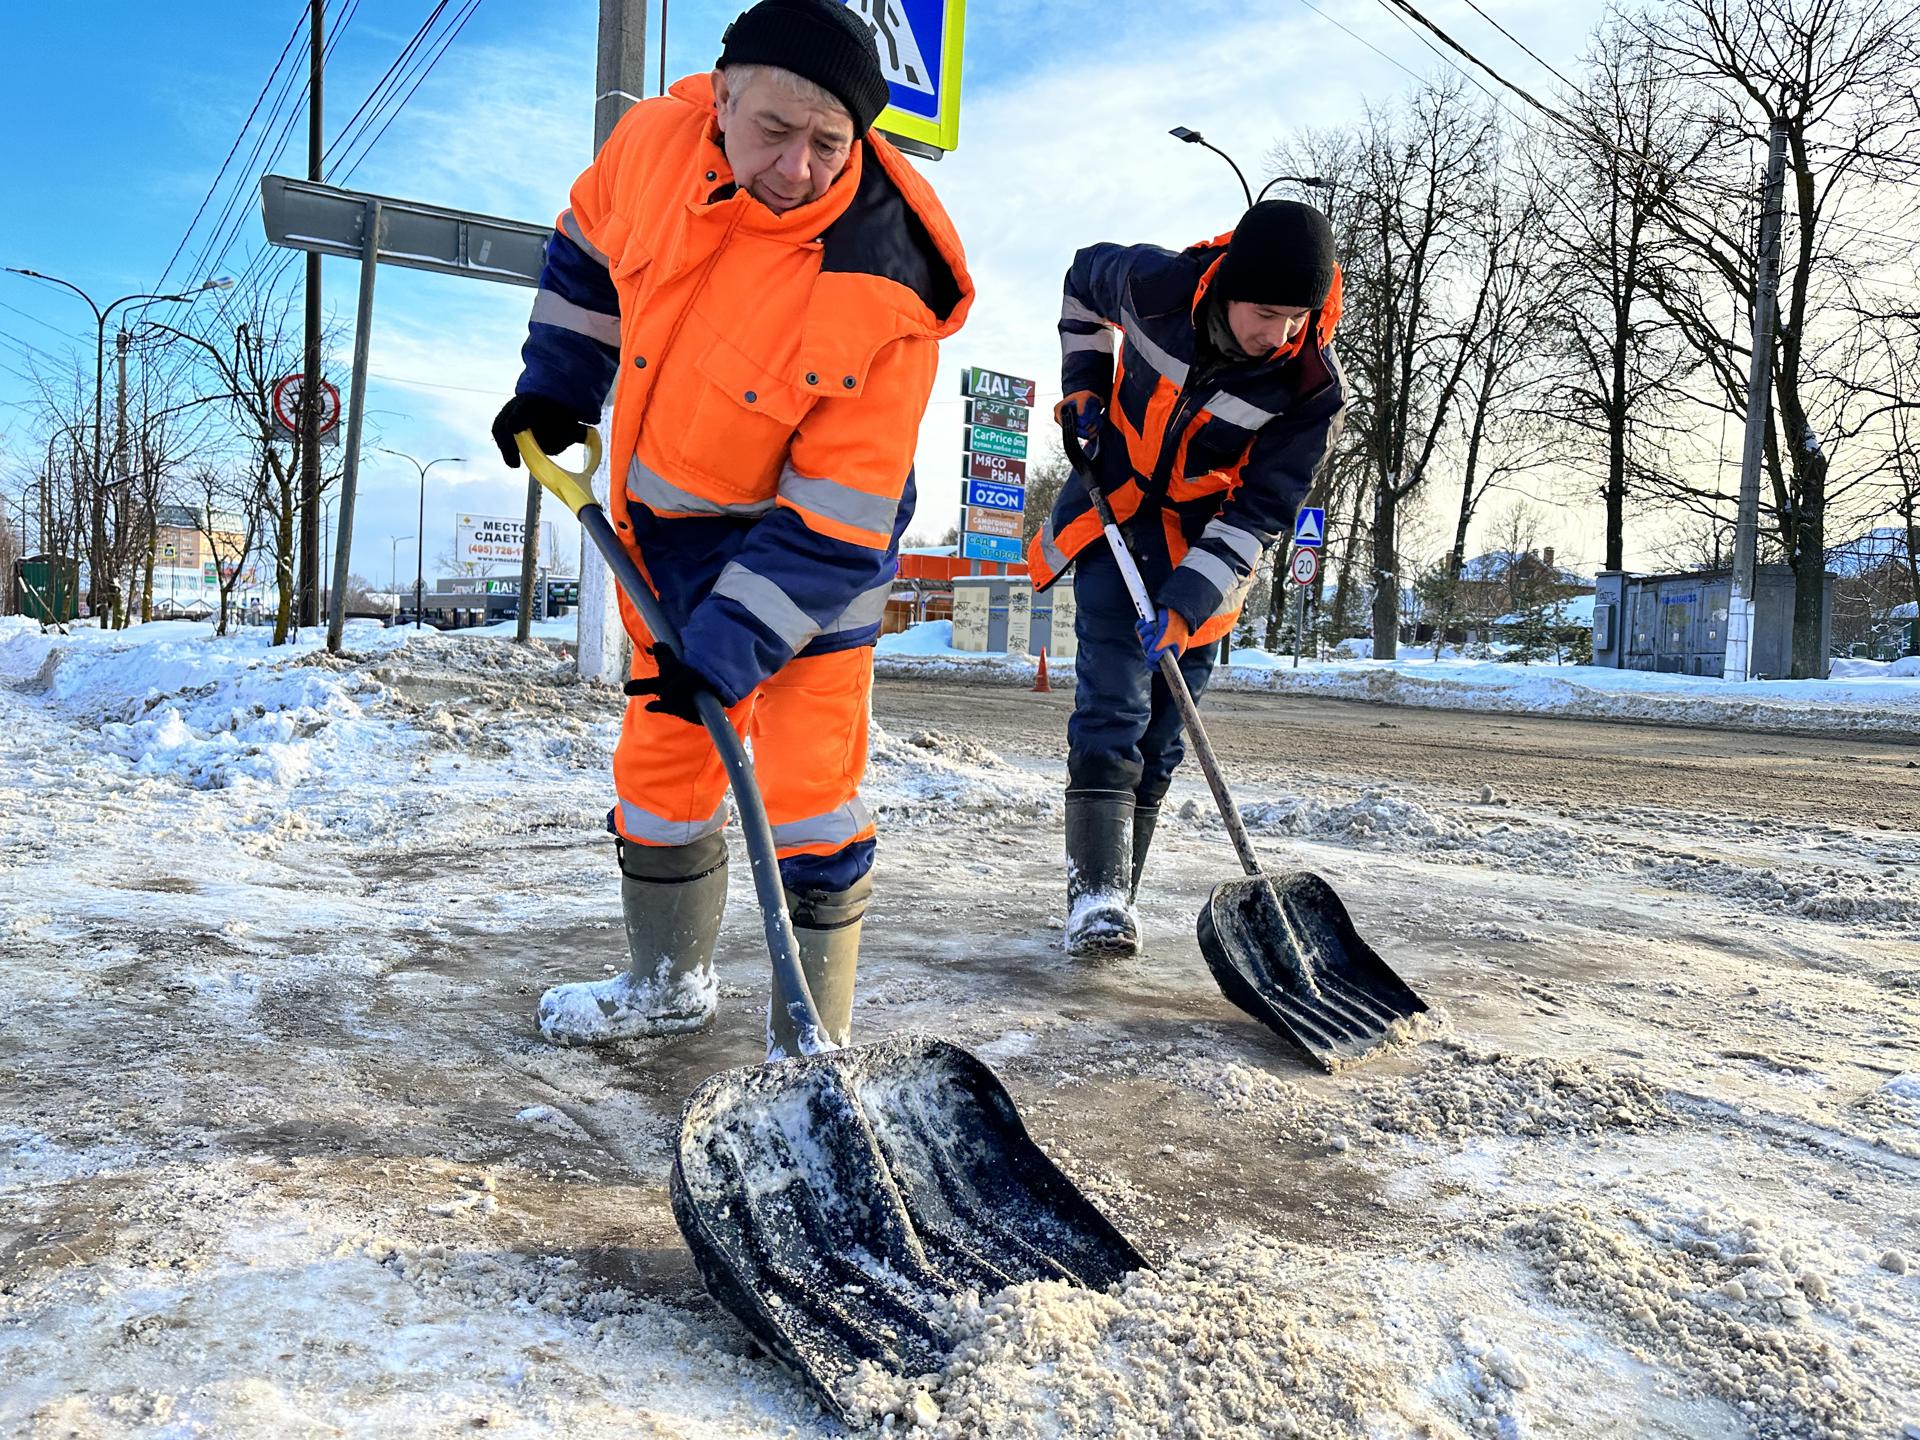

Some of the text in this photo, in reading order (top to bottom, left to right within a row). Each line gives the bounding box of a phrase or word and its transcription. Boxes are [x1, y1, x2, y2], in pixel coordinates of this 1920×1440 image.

[975, 371, 1010, 398] ДА!
[974, 428, 1013, 445] CarPrice
[975, 454, 1007, 469] МЯСО
[991, 469, 1021, 484] РЫБА
[975, 489, 1019, 508] OZON
[968, 535, 990, 546] САД
[982, 549, 1021, 560] ОГОРОД
[1298, 560, 1313, 575] 20
[491, 580, 513, 594] ДА!
